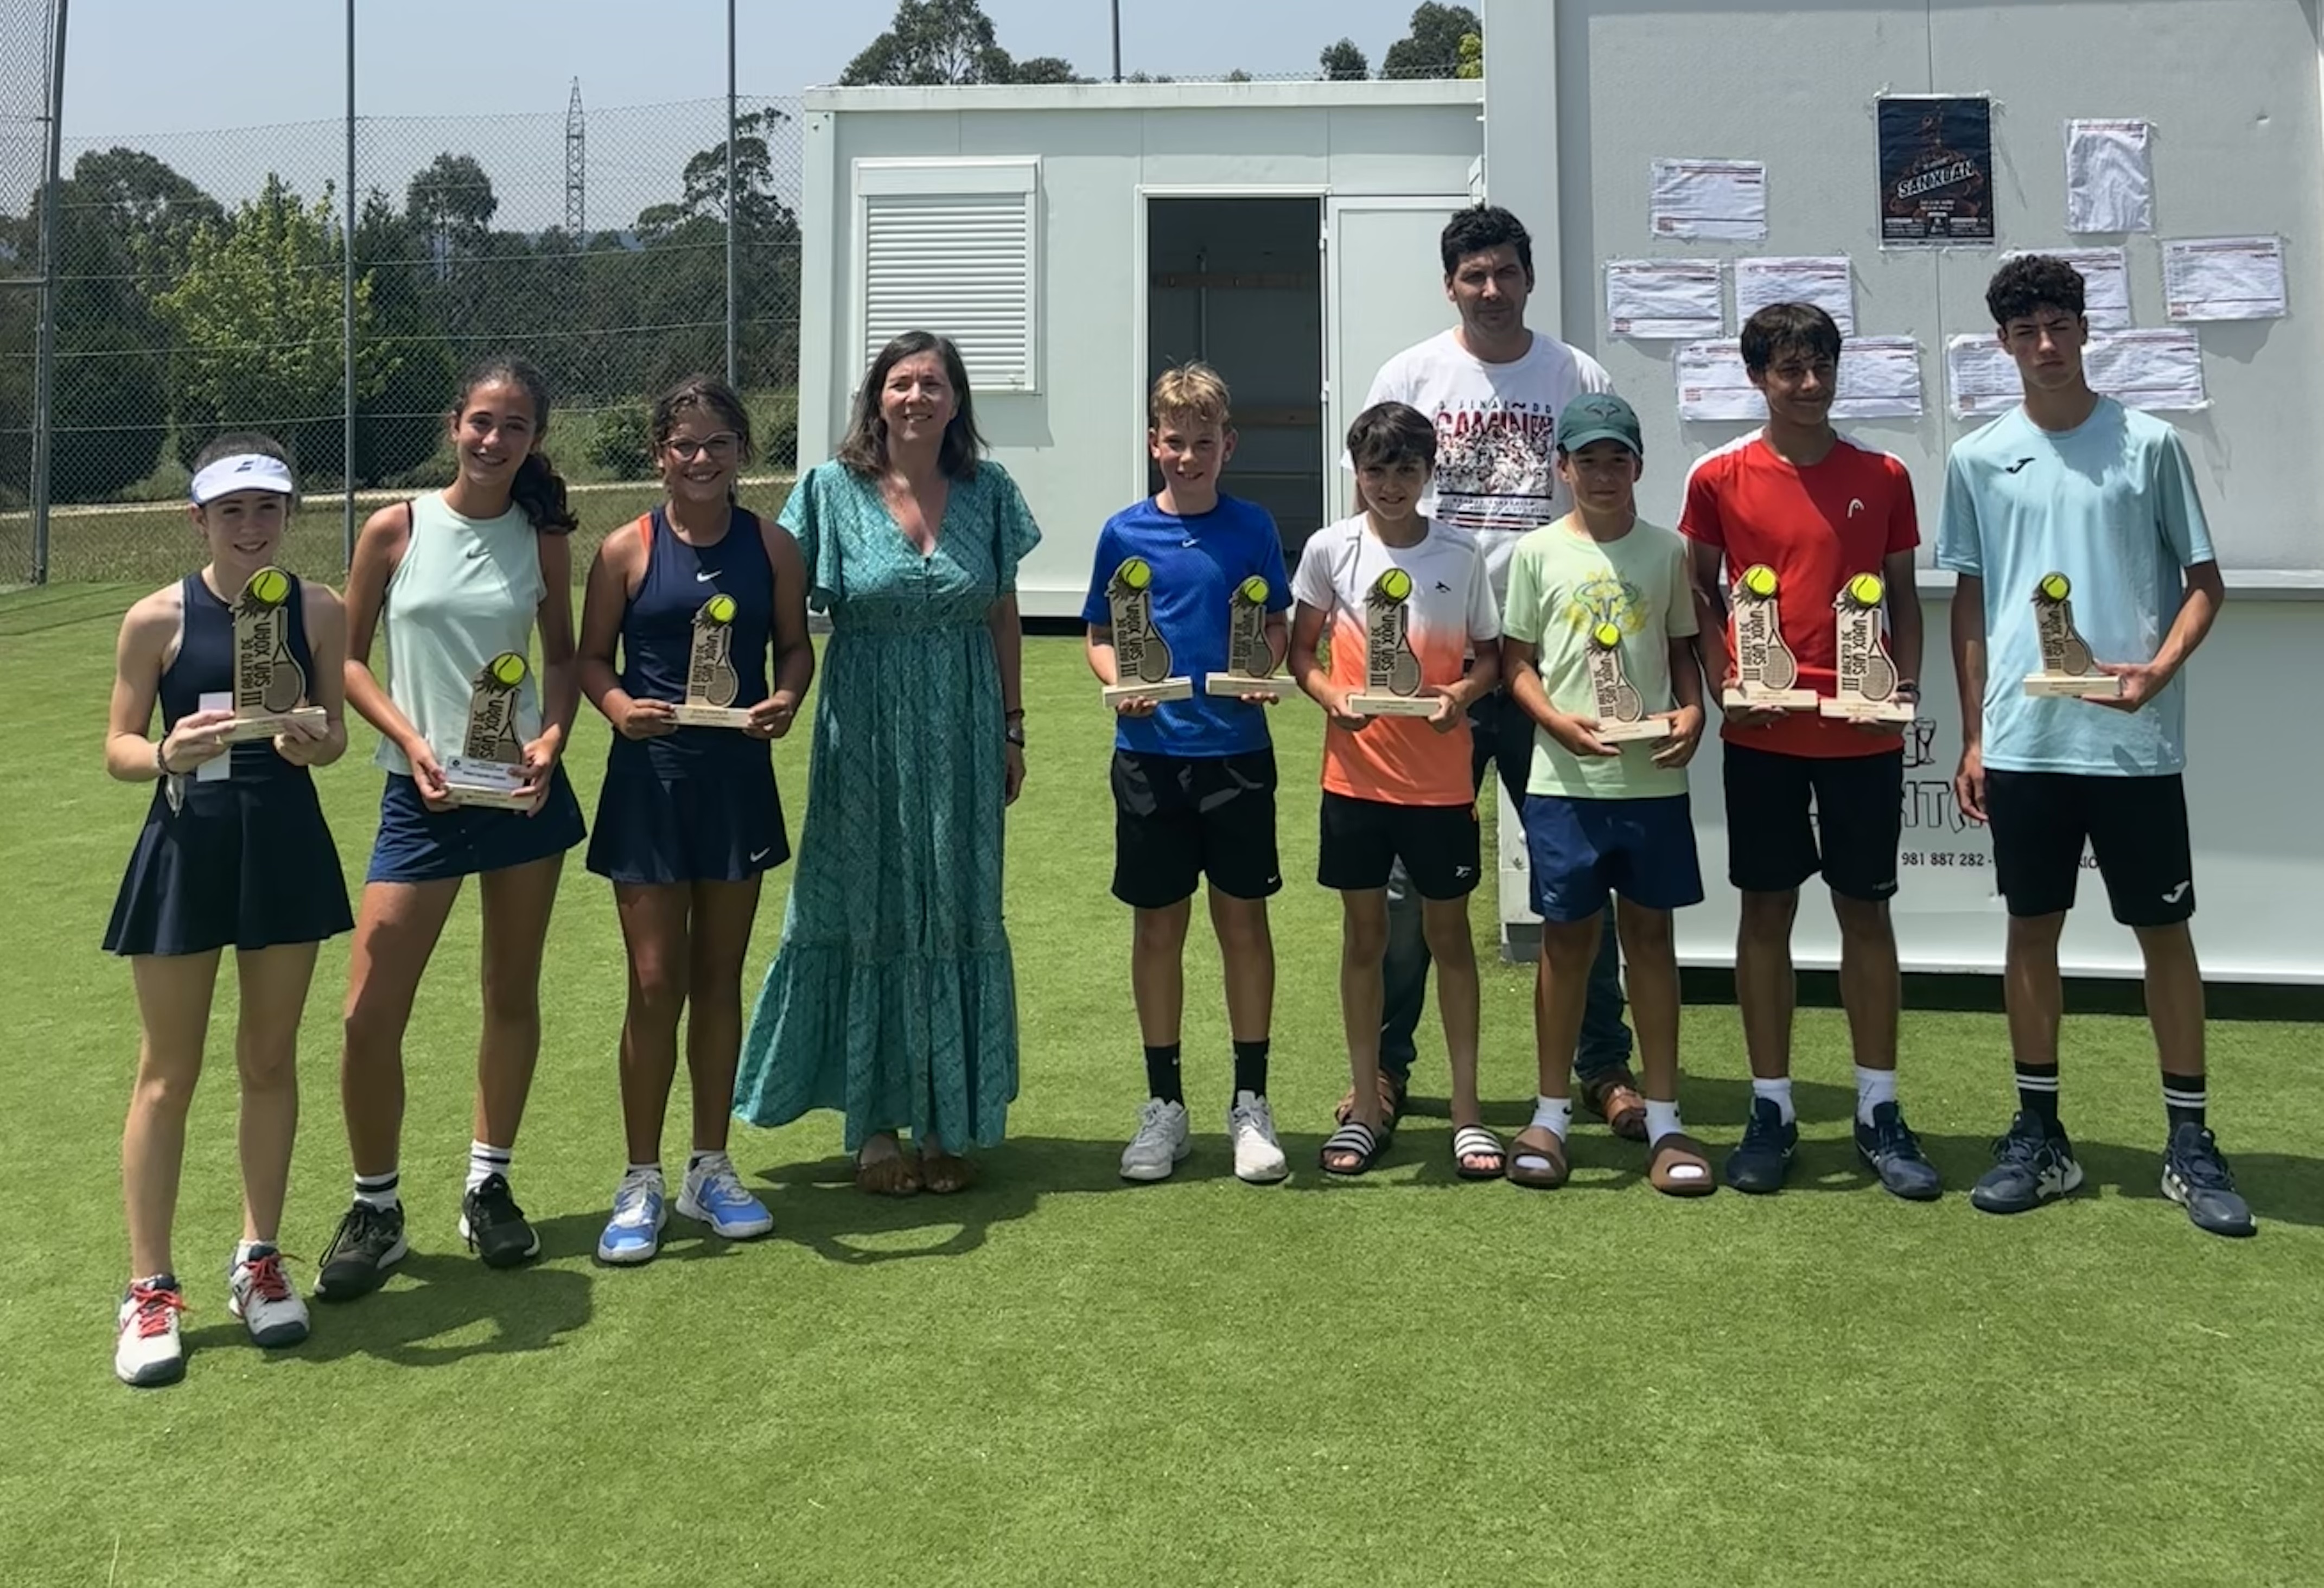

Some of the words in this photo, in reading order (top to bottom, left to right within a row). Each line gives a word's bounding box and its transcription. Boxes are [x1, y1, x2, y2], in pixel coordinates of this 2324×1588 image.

[254, 623, 271, 657] XOAN
[1381, 615, 1395, 645] XOAN
[1852, 620, 1867, 649] XOAN
[241, 638, 253, 649] DE
[1381, 648, 1395, 671] SAN
[1753, 645, 1766, 665] SAN
[1853, 653, 1867, 674] SAN
[241, 654, 253, 688] ABERTO
[254, 661, 271, 687] SAN
[1120, 662, 1137, 677] III
[1371, 674, 1387, 686] III
[1743, 668, 1760, 680] III
[1842, 678, 1858, 690] III
[241, 691, 262, 706] III
[485, 700, 504, 731] XOAN
[480, 736, 496, 758] SAN
[1901, 852, 1925, 865] 981
[1930, 852, 1954, 866] 887
[1959, 853, 1984, 866] 282
